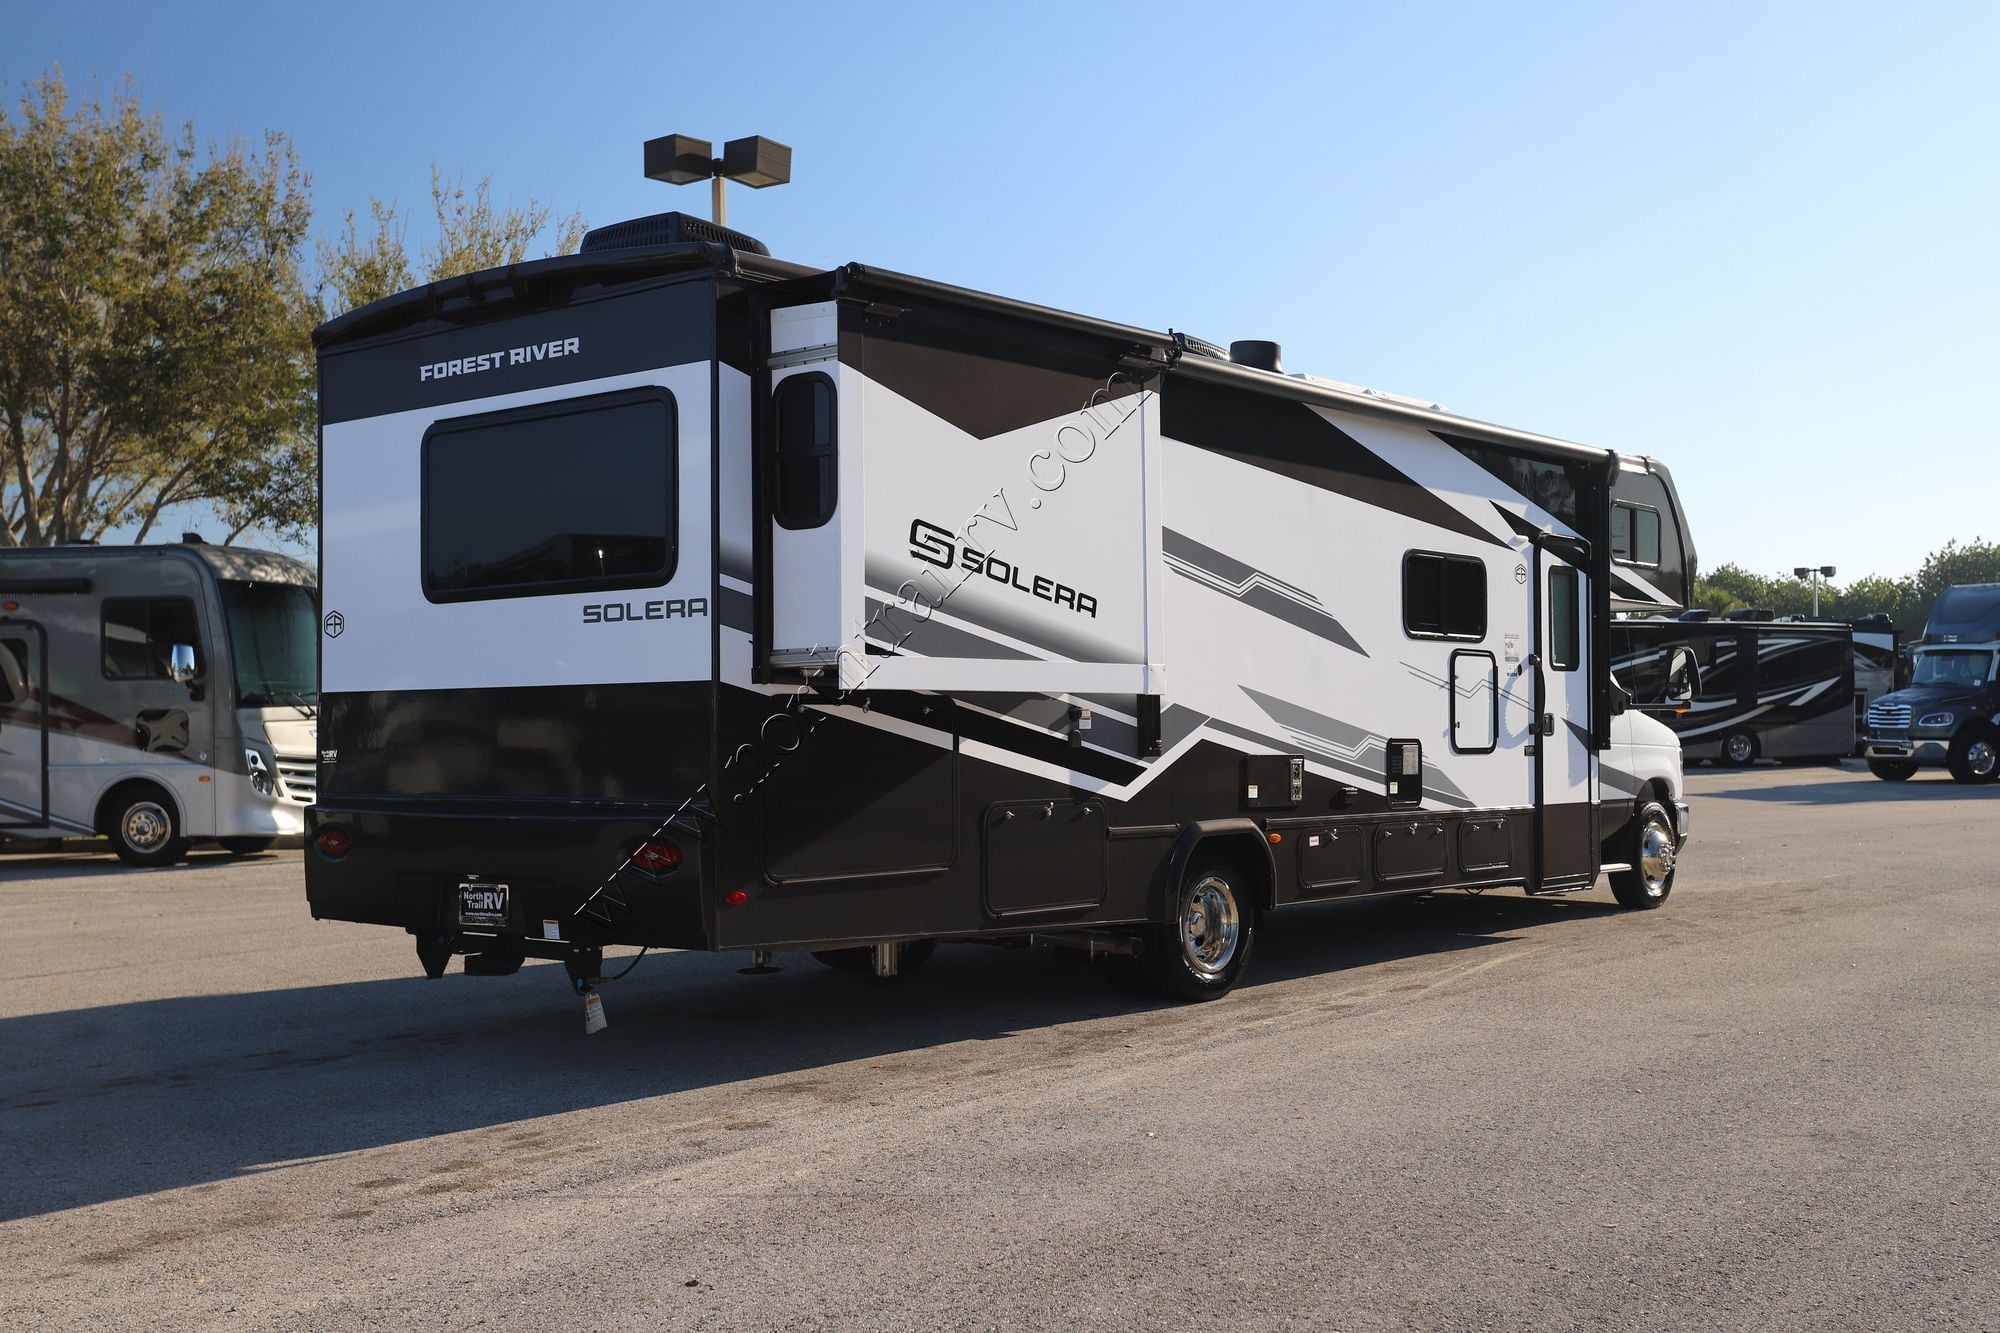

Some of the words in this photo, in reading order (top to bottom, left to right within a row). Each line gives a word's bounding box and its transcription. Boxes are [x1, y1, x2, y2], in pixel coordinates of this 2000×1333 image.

[420, 351, 504, 382] FOREST
[509, 337, 579, 365] RIVER
[961, 546, 1098, 619] SOLERA
[583, 597, 708, 624] SOLERA
[463, 891, 484, 901] North
[467, 900, 483, 909] Trail
[483, 892, 504, 910] RV
